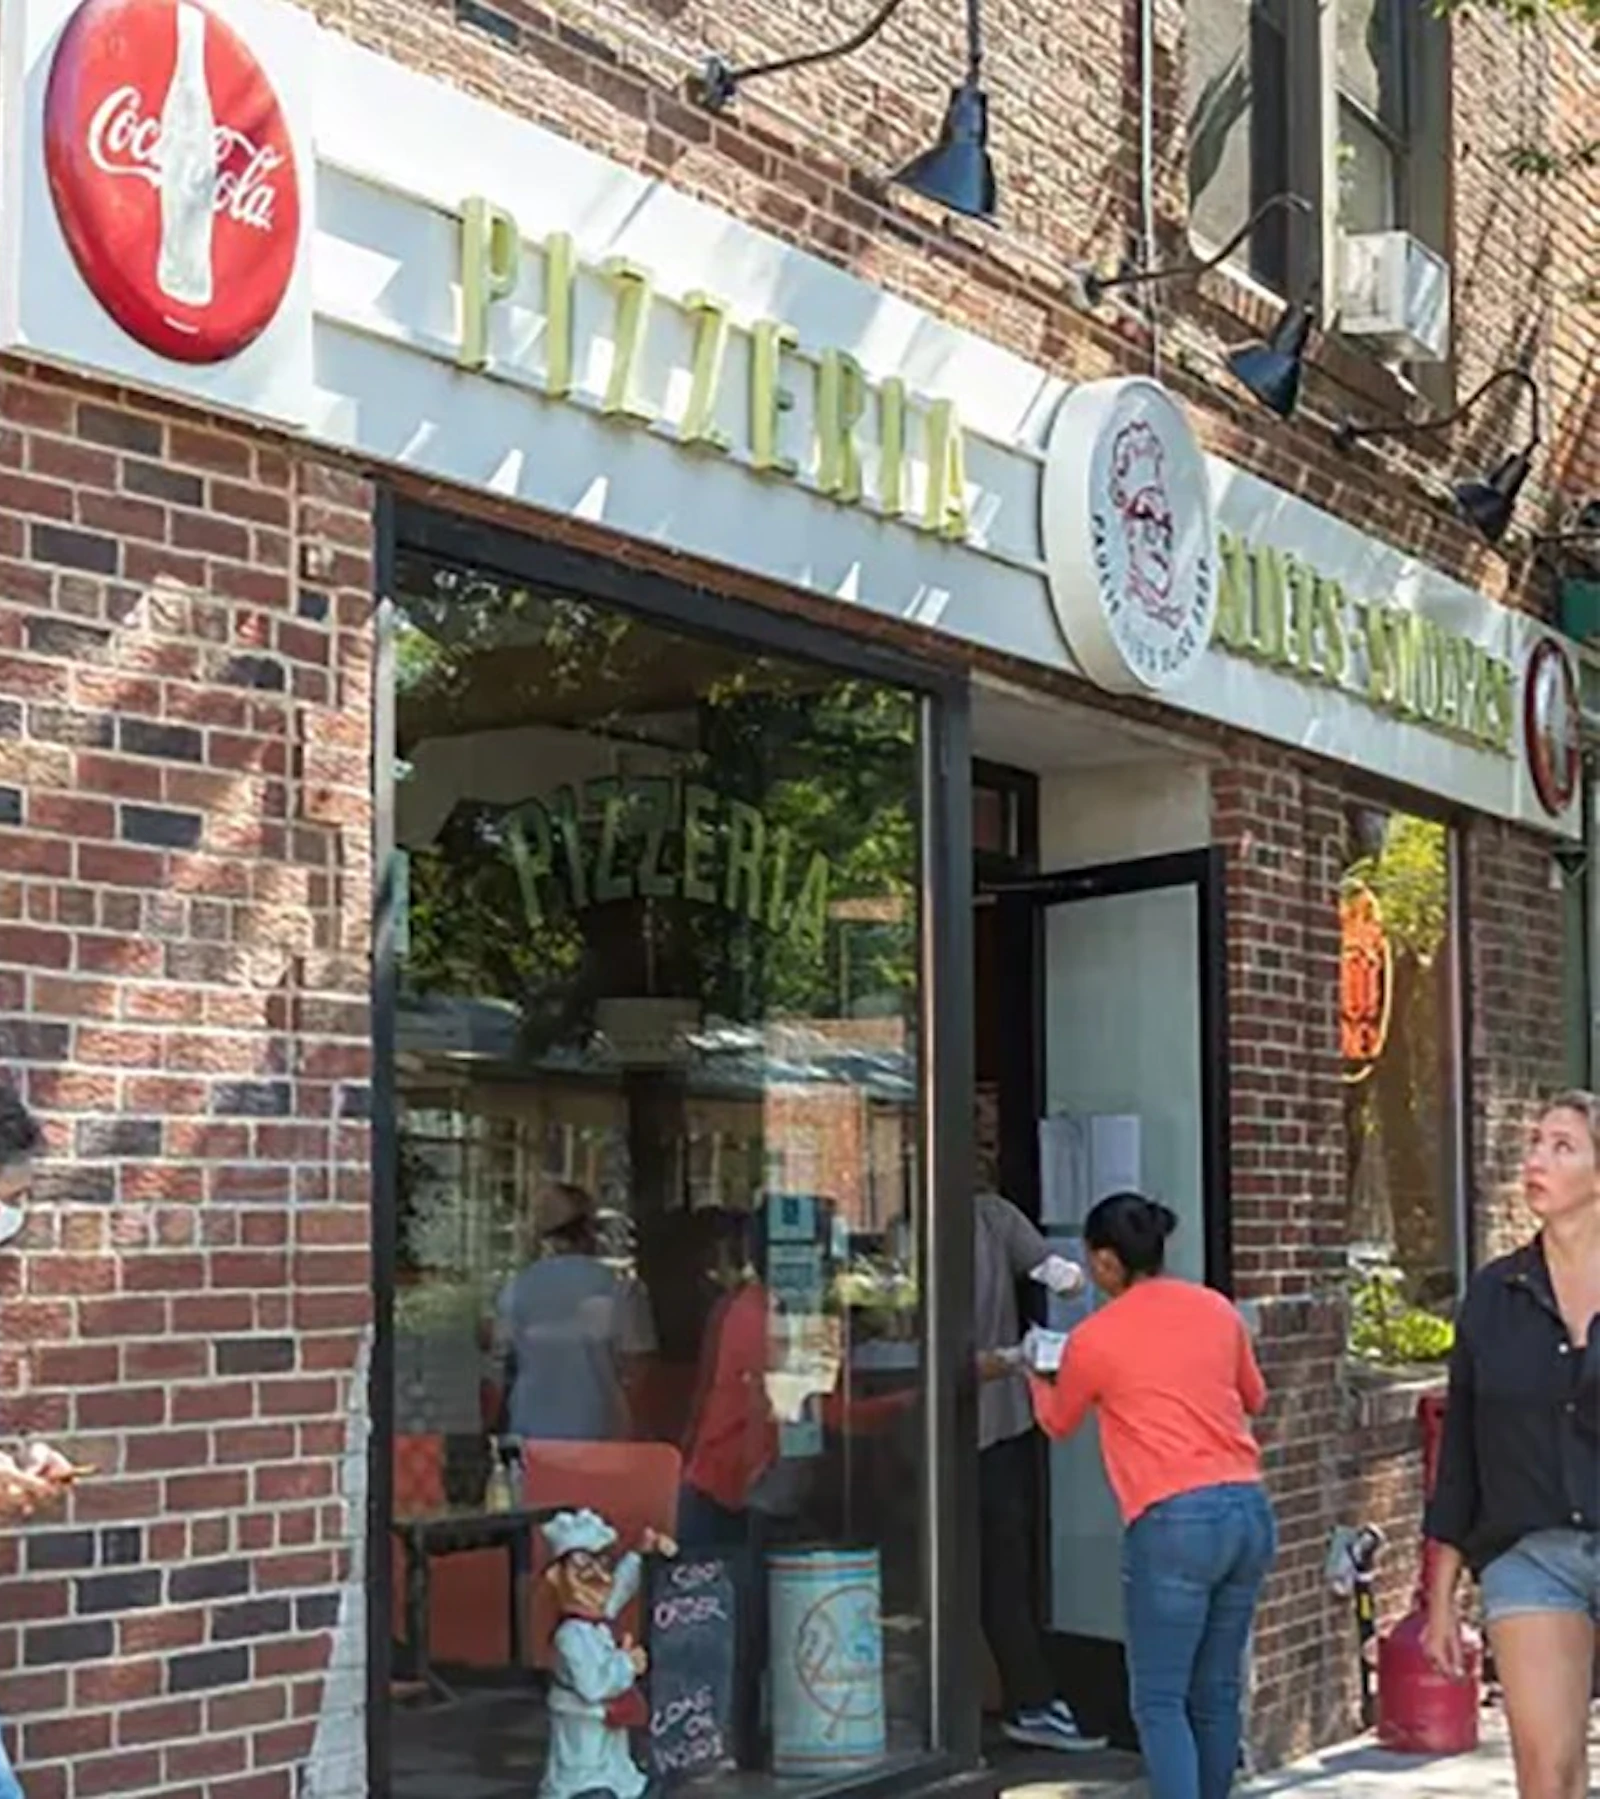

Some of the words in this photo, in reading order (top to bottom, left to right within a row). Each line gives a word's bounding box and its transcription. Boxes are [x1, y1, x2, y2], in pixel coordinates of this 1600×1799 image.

[87, 83, 287, 233] CocCola
[458, 196, 967, 542] PIZZERIA
[501, 775, 830, 966] PIZZERIA
